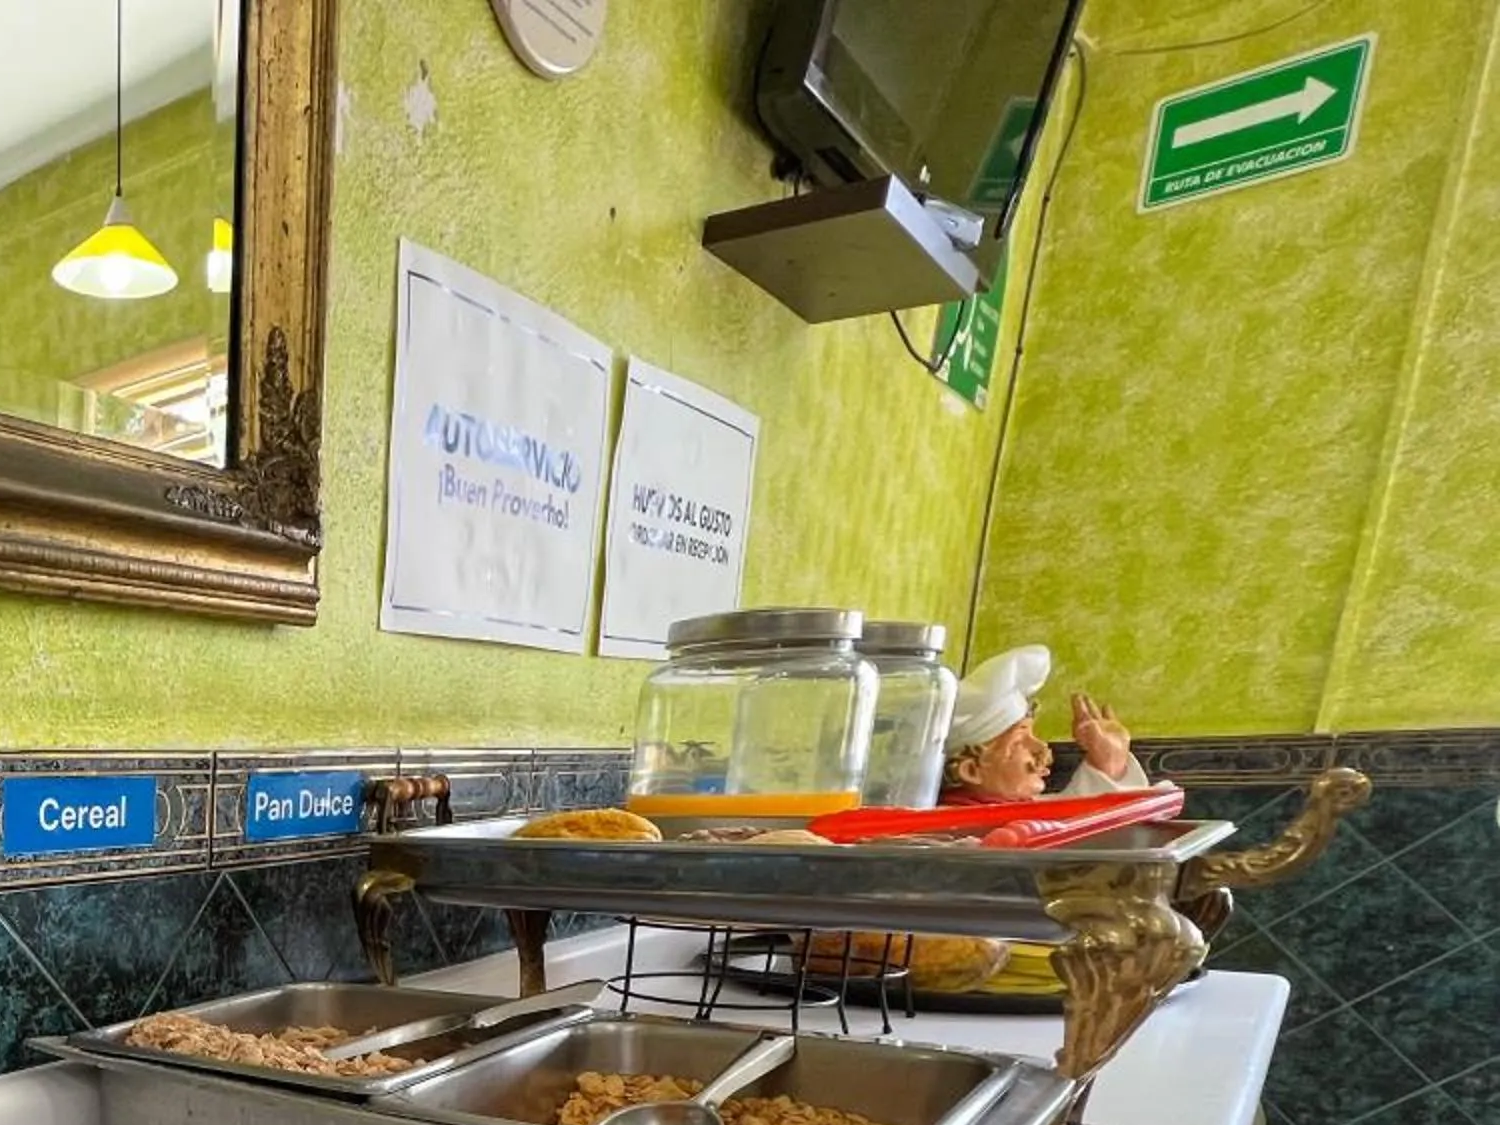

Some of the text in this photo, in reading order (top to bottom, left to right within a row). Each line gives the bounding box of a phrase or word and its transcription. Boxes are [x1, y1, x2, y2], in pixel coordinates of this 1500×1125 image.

[1164, 175, 1201, 193] RUTA
[1203, 166, 1226, 184] DE
[426, 403, 582, 494] AUTORVICIO
[699, 504, 733, 538] GUSTO
[39, 795, 127, 831] Cereal
[254, 787, 354, 822] Pan Dulce
